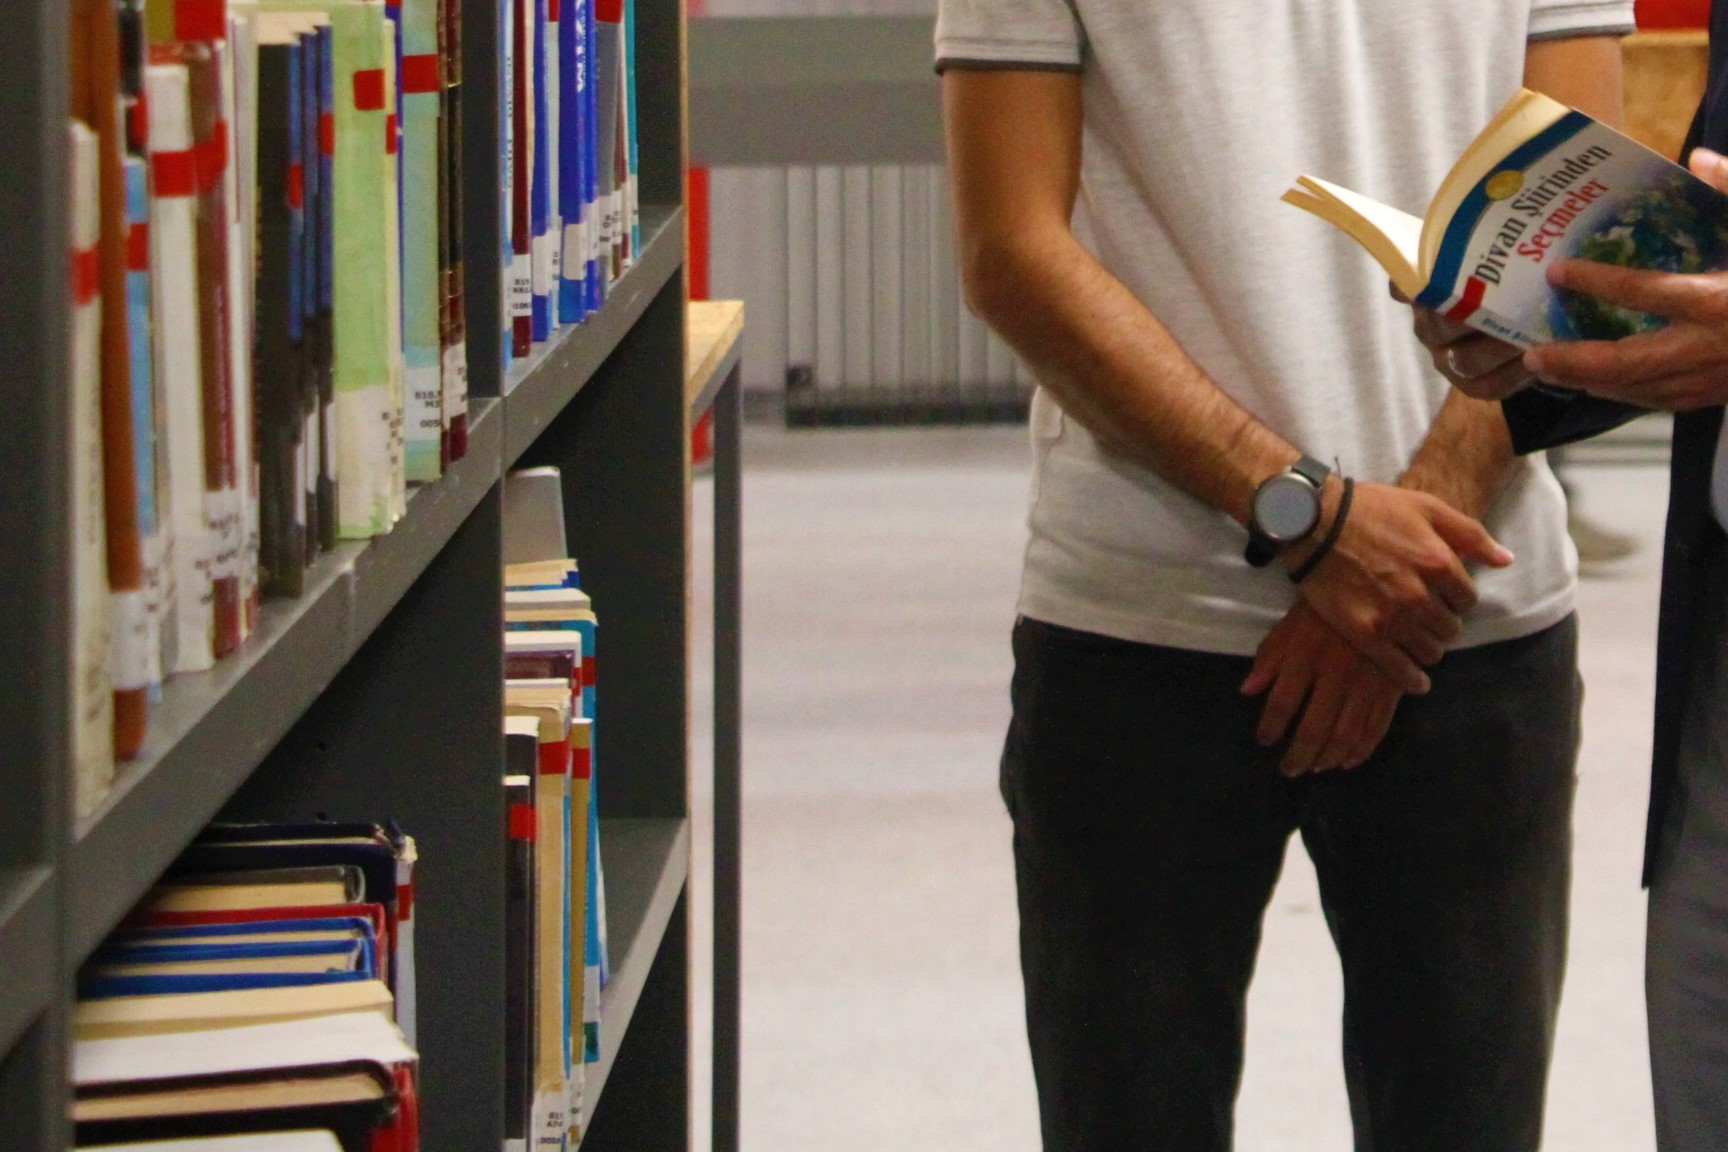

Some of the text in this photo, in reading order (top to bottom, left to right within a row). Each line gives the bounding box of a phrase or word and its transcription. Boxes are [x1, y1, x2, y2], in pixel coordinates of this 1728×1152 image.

[1475, 216, 1528, 285] Divan
[1511, 144, 1613, 218] Şiirinden
[1516, 177, 1610, 265] Seçmeler
